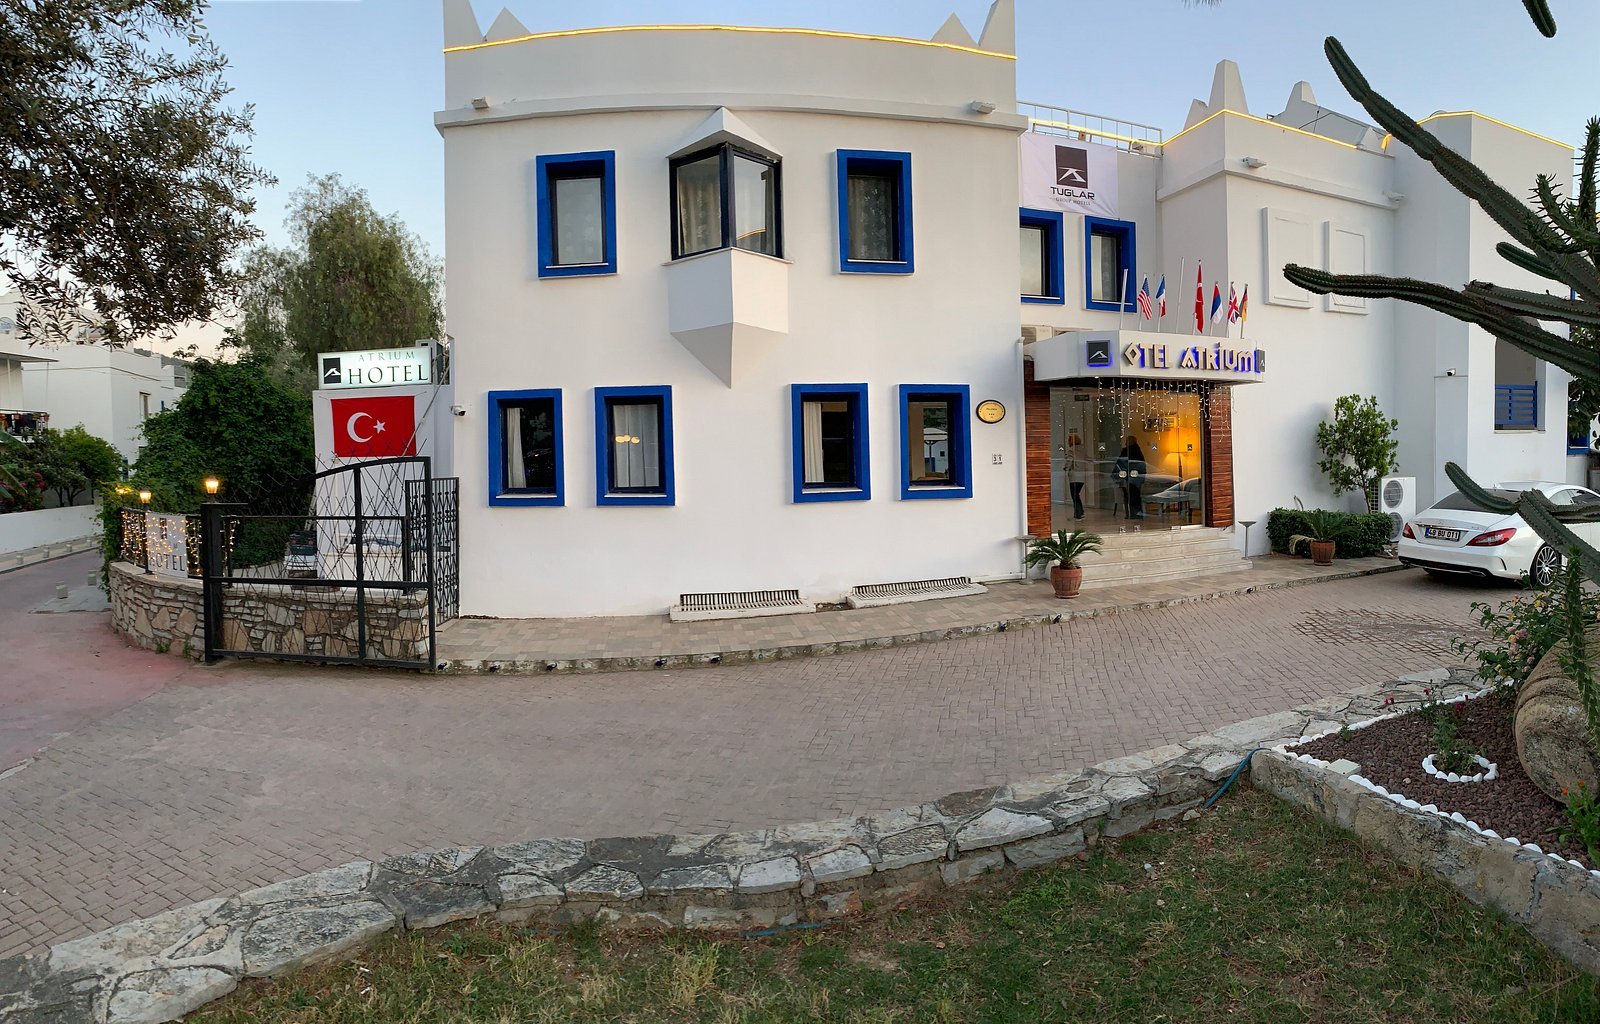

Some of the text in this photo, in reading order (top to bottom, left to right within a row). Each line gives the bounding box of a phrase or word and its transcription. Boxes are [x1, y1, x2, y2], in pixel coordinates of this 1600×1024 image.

[1050, 186, 1095, 201] TUGLAR
[359, 351, 415, 362] ATRIUM
[1123, 342, 1173, 369] OTEL
[348, 364, 428, 384] HOTEL
